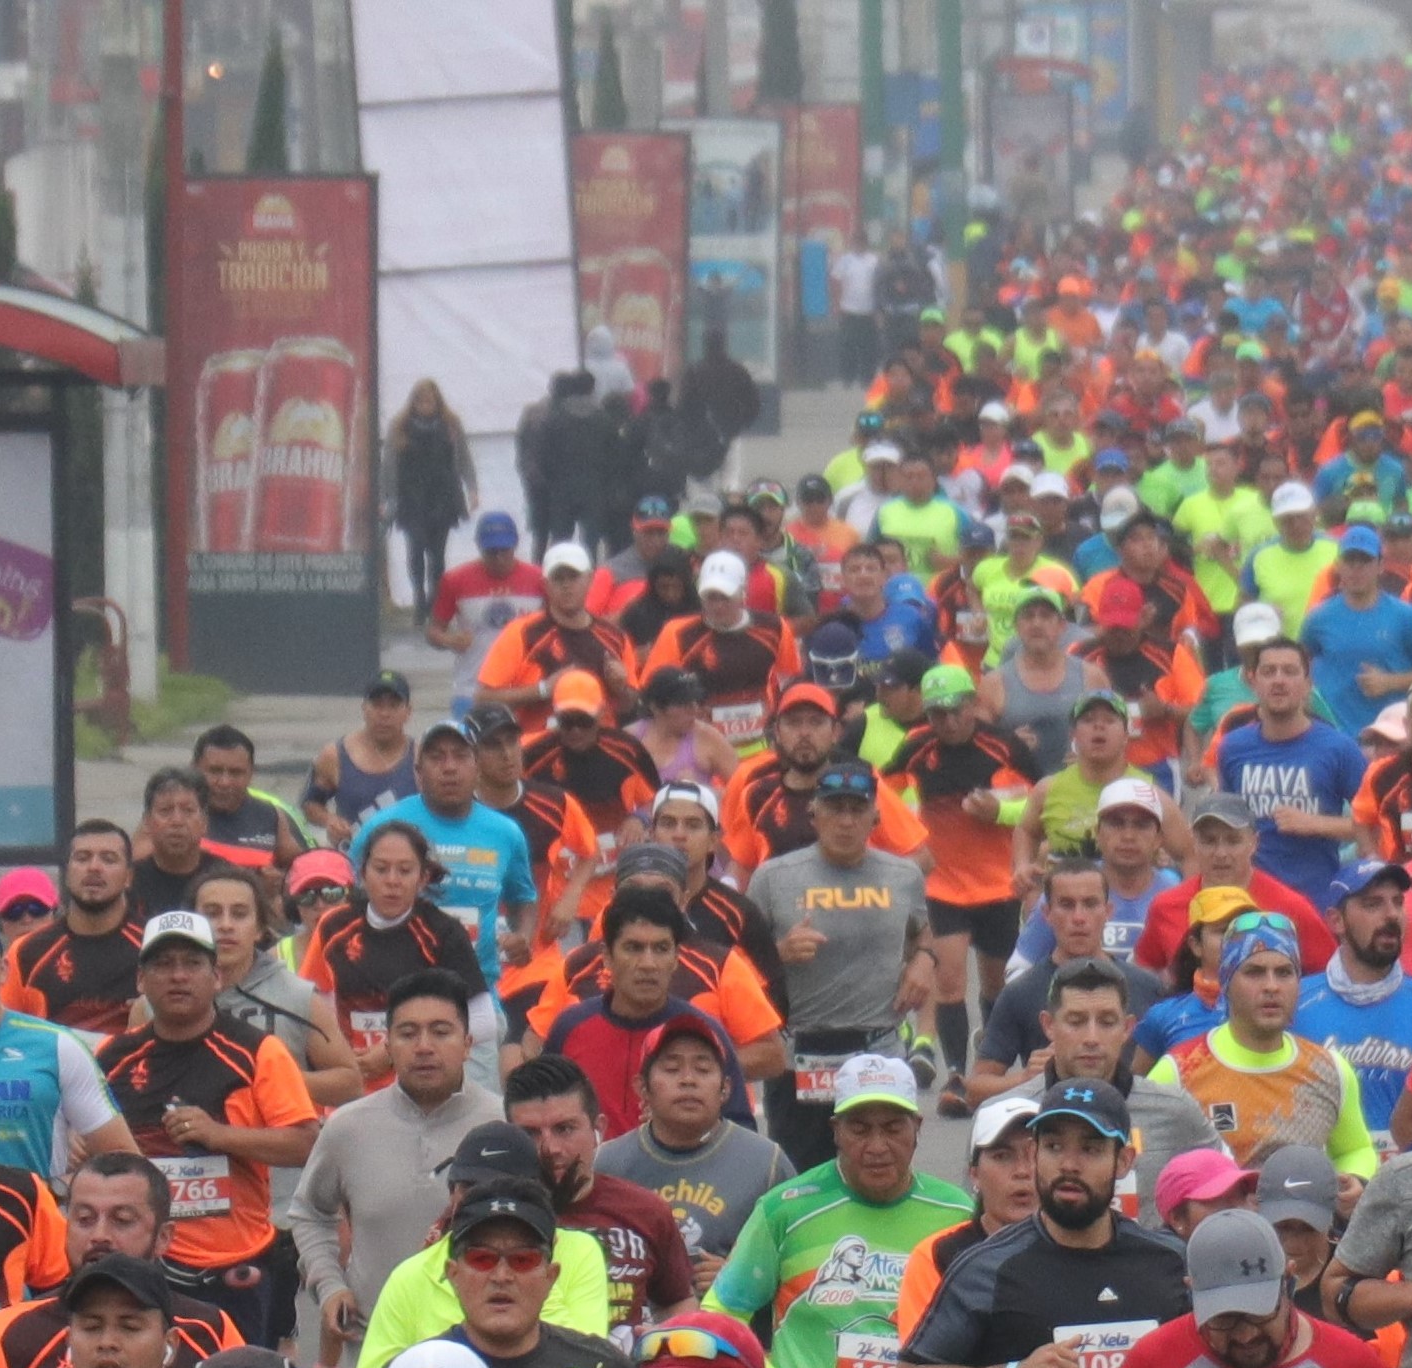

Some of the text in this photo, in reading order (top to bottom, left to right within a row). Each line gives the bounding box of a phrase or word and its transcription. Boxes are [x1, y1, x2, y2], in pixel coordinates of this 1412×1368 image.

[1241, 763, 1308, 797] MAYA
[804, 887, 889, 909] RUN
[818, 1289, 853, 1304] 2018
[1098, 1333, 1130, 1348] Xela
